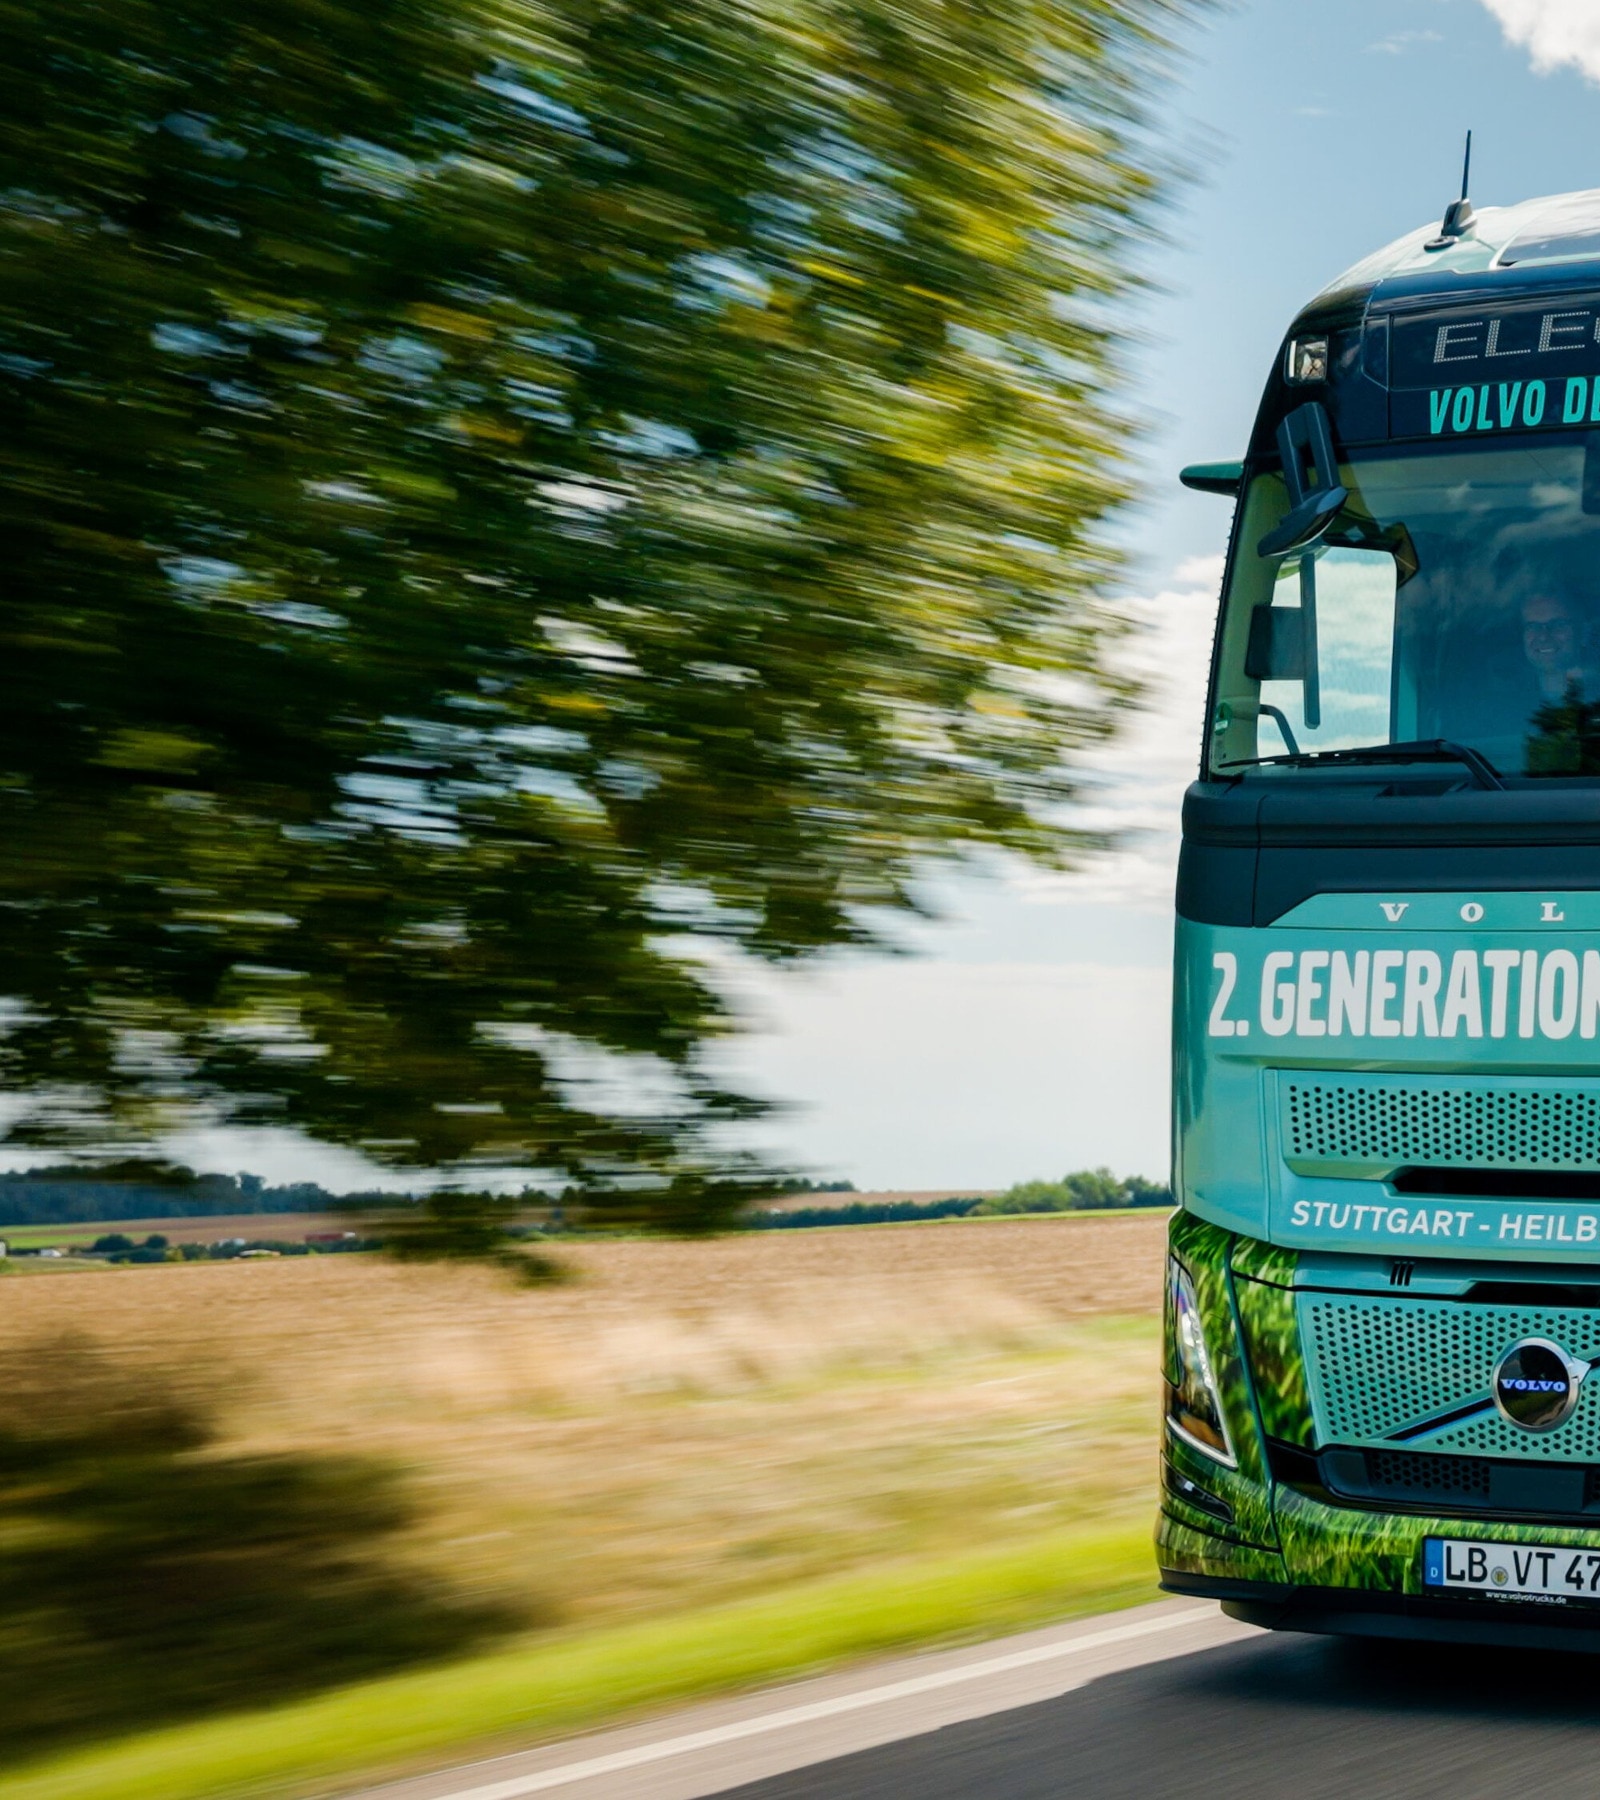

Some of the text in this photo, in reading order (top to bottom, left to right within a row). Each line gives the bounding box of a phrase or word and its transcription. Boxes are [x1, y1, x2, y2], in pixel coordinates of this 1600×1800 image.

[1429, 376, 1546, 435] VOLVO
[1208, 951, 1248, 1037] 2.
[1290, 1200, 1472, 1237] STUTTGART
[1500, 1378, 1567, 1392] VOLVO
[1445, 1545, 1489, 1583] LB
[1513, 1550, 1556, 1588] VT
[1485, 1591, 1567, 1605] www.volvotrucks.de
